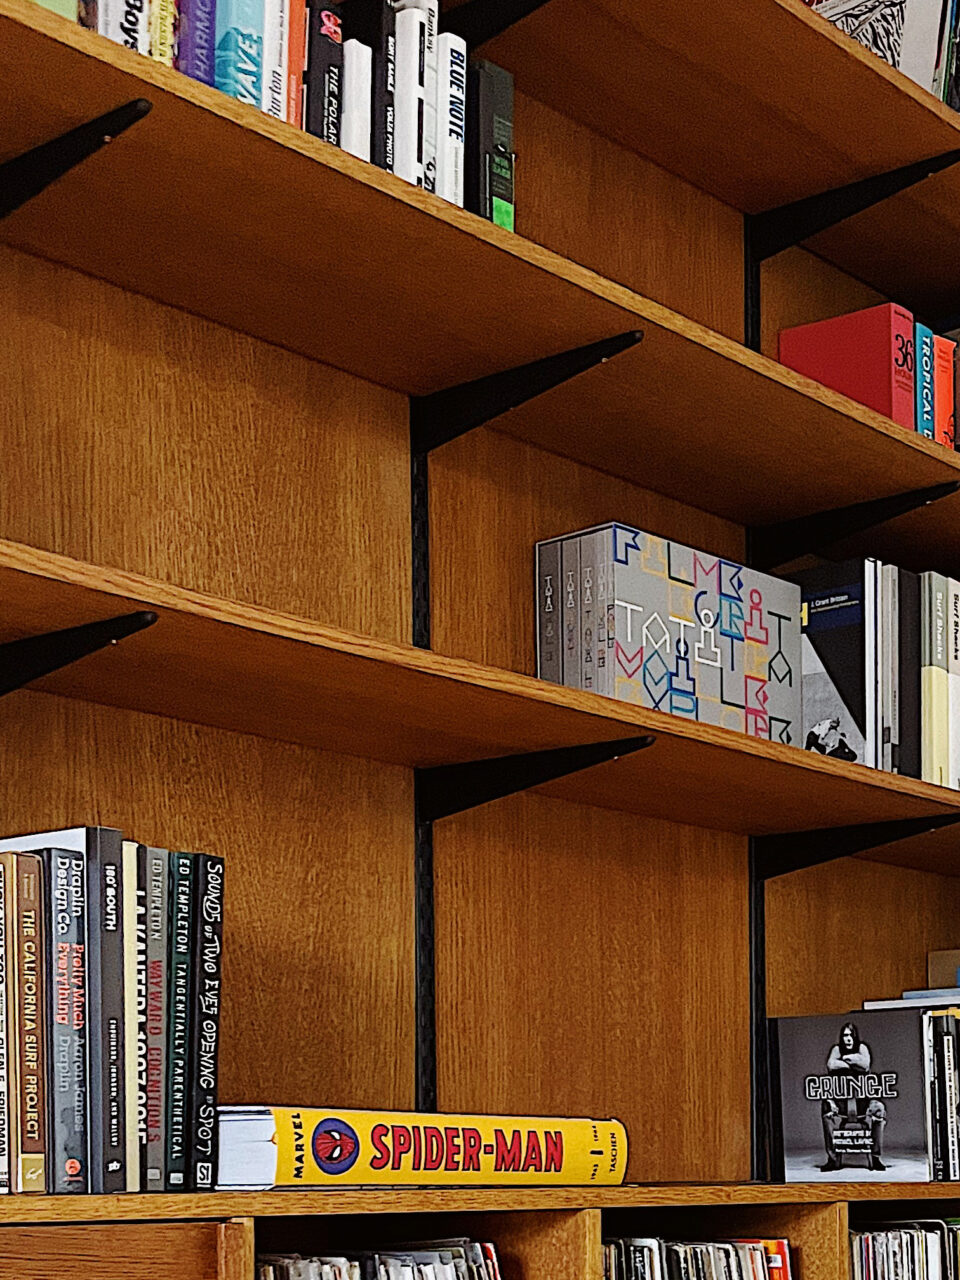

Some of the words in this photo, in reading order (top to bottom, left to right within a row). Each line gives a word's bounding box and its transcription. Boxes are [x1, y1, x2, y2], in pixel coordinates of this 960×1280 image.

[327, 65, 338, 96] THE
[450, 47, 465, 95] BLUE
[328, 97, 339, 145] POLAR
[448, 94, 465, 143] NOTE
[386, 134, 394, 165] PHOTO
[894, 333, 913, 372] 36
[922, 335, 933, 421] TROPICAL
[55, 857, 70, 912] Design
[70, 859, 83, 917] Draplin
[151, 858, 162, 873] ED
[178, 858, 190, 876] ED
[104, 889, 116, 931] SOUTH
[151, 873, 162, 941] TEMPLETON
[177, 878, 190, 954] TEMPLETON
[202, 861, 222, 922] SOUNDS
[22, 909, 35, 937] THE
[203, 937, 219, 973] TWO
[22, 940, 37, 1031] CALIFORNIA
[55, 942, 70, 1024] Everything
[148, 959, 162, 1036] WAYWARD
[200, 979, 219, 1015] EYES
[72, 989, 84, 1030] Much
[174, 963, 187, 1055] TANGENTIALLY
[24, 1034, 37, 1070] SURF
[199, 1019, 218, 1089] OPENING
[25, 1075, 38, 1140] PROJECT
[110, 1102, 118, 1116] AND
[149, 1047, 162, 1143] COGNITIONS
[171, 1059, 184, 1160] PARENTHETICAL
[805, 1073, 898, 1100] GRUNGE
[197, 1104, 216, 1155] SPOT
[292, 1113, 303, 1179] MARVEL
[369, 1123, 564, 1173] SPIDER-MAN
[609, 1132, 617, 1173] TASCHEN
